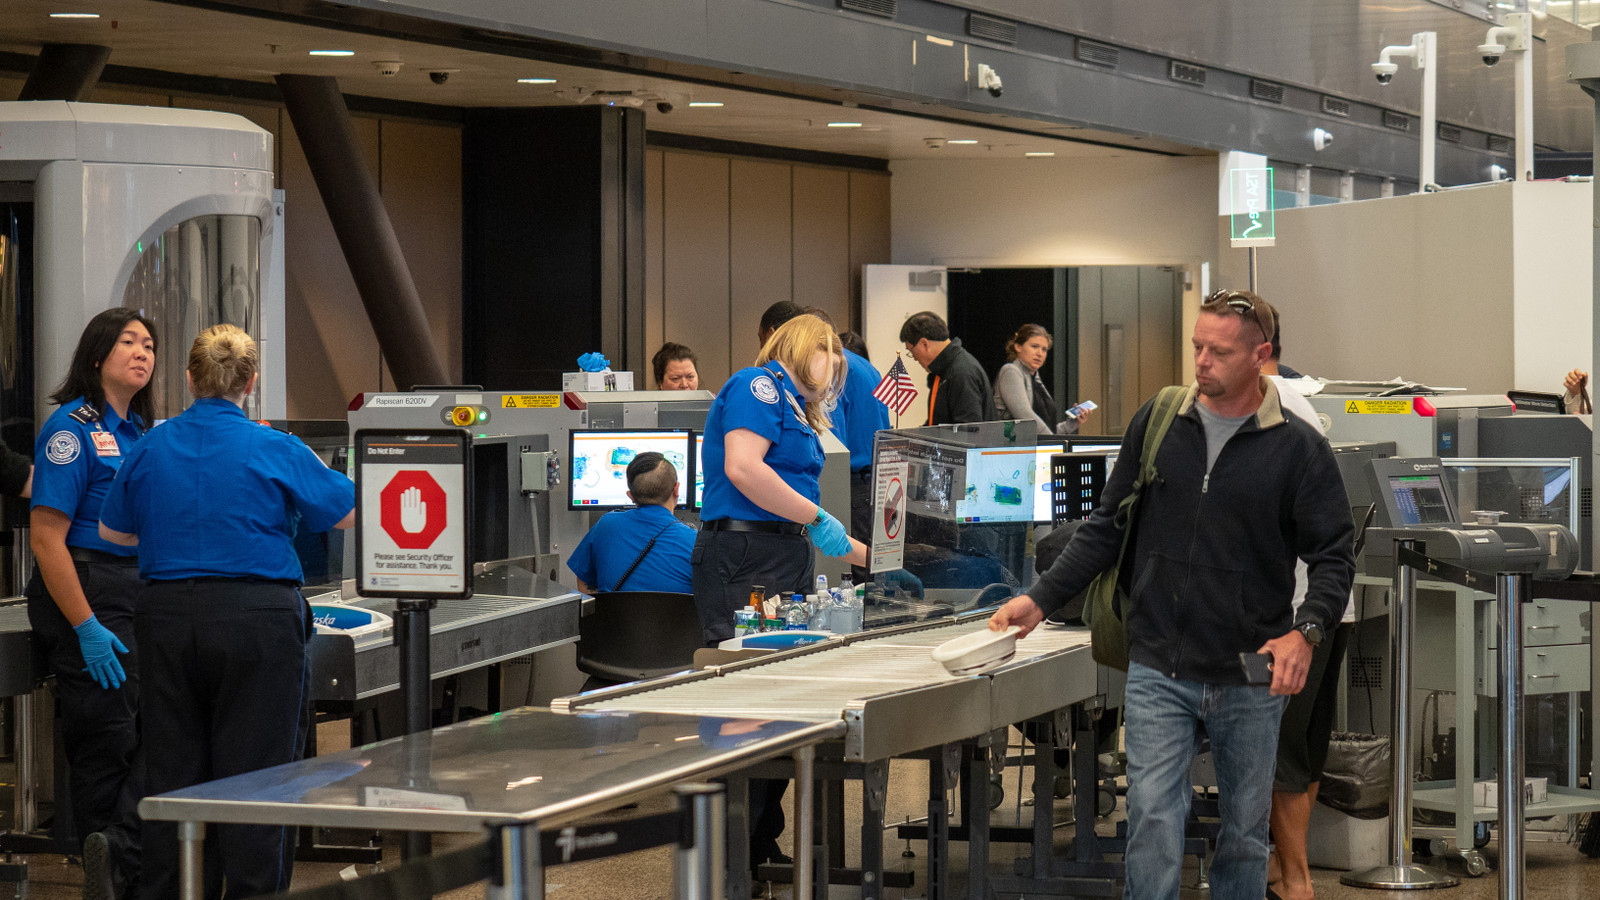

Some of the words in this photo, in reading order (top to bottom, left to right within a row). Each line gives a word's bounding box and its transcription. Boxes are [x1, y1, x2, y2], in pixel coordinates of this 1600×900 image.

[375, 397, 404, 406] Rapiscan
[367, 447, 376, 455] Do
[377, 447, 389, 455] Not
[389, 447, 405, 455] Enter
[374, 552, 394, 560] Please
[407, 553, 432, 562] Security
[375, 561, 384, 569] for
[386, 561, 417, 569] assistance.
[439, 563, 453, 571] you.
